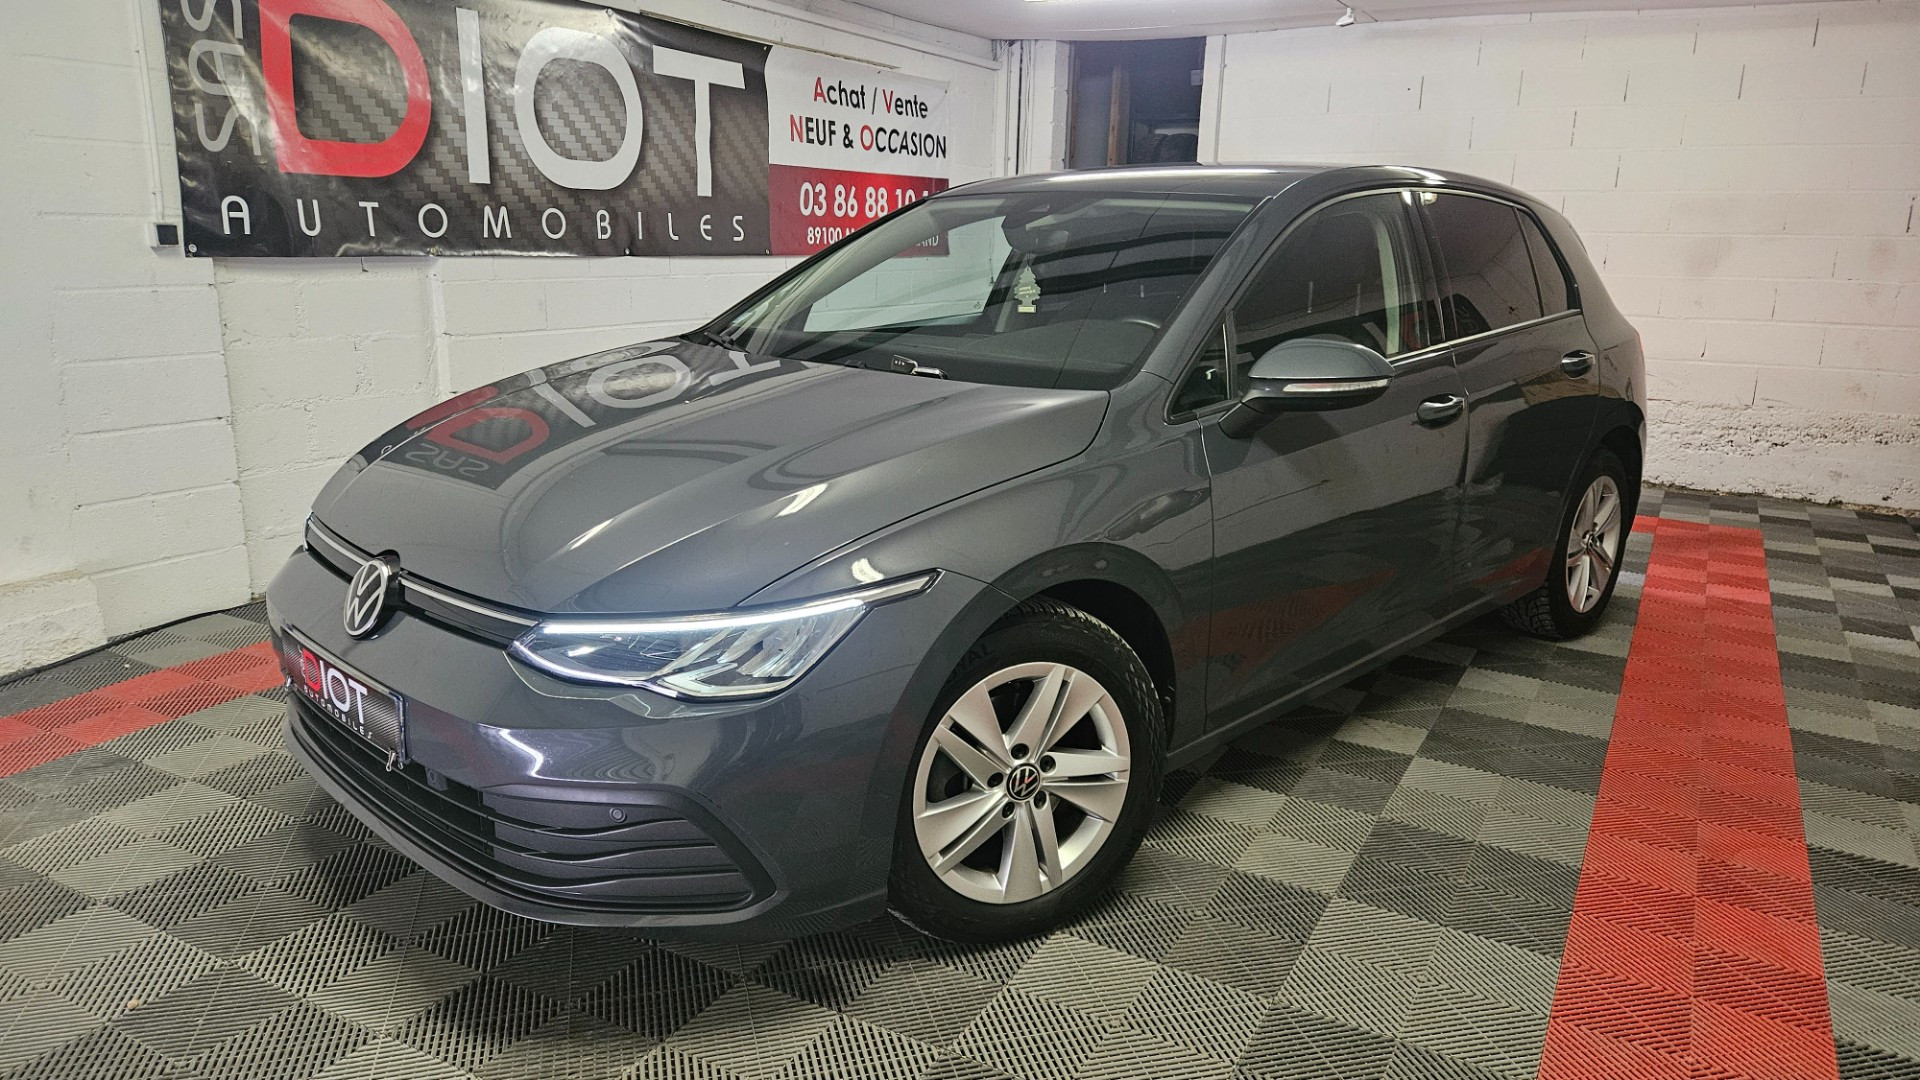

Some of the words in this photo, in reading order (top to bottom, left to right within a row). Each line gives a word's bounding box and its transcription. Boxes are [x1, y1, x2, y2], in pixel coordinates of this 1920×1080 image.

[259, 0, 746, 198] DIOT
[813, 77, 866, 110] Achat
[871, 87, 878, 115] /
[882, 89, 928, 118] Vente
[789, 114, 837, 146] NEUF
[843, 123, 854, 149] &
[860, 125, 947, 159] OCCASION
[221, 195, 745, 242] AUTOMOBILES
[799, 181, 827, 217] 03
[833, 184, 859, 218] 86
[865, 186, 889, 218] 88
[807, 226, 843, 245] 89100
[302, 647, 369, 724] DIOT
[303, 685, 373, 739] AUTOMOBILES
